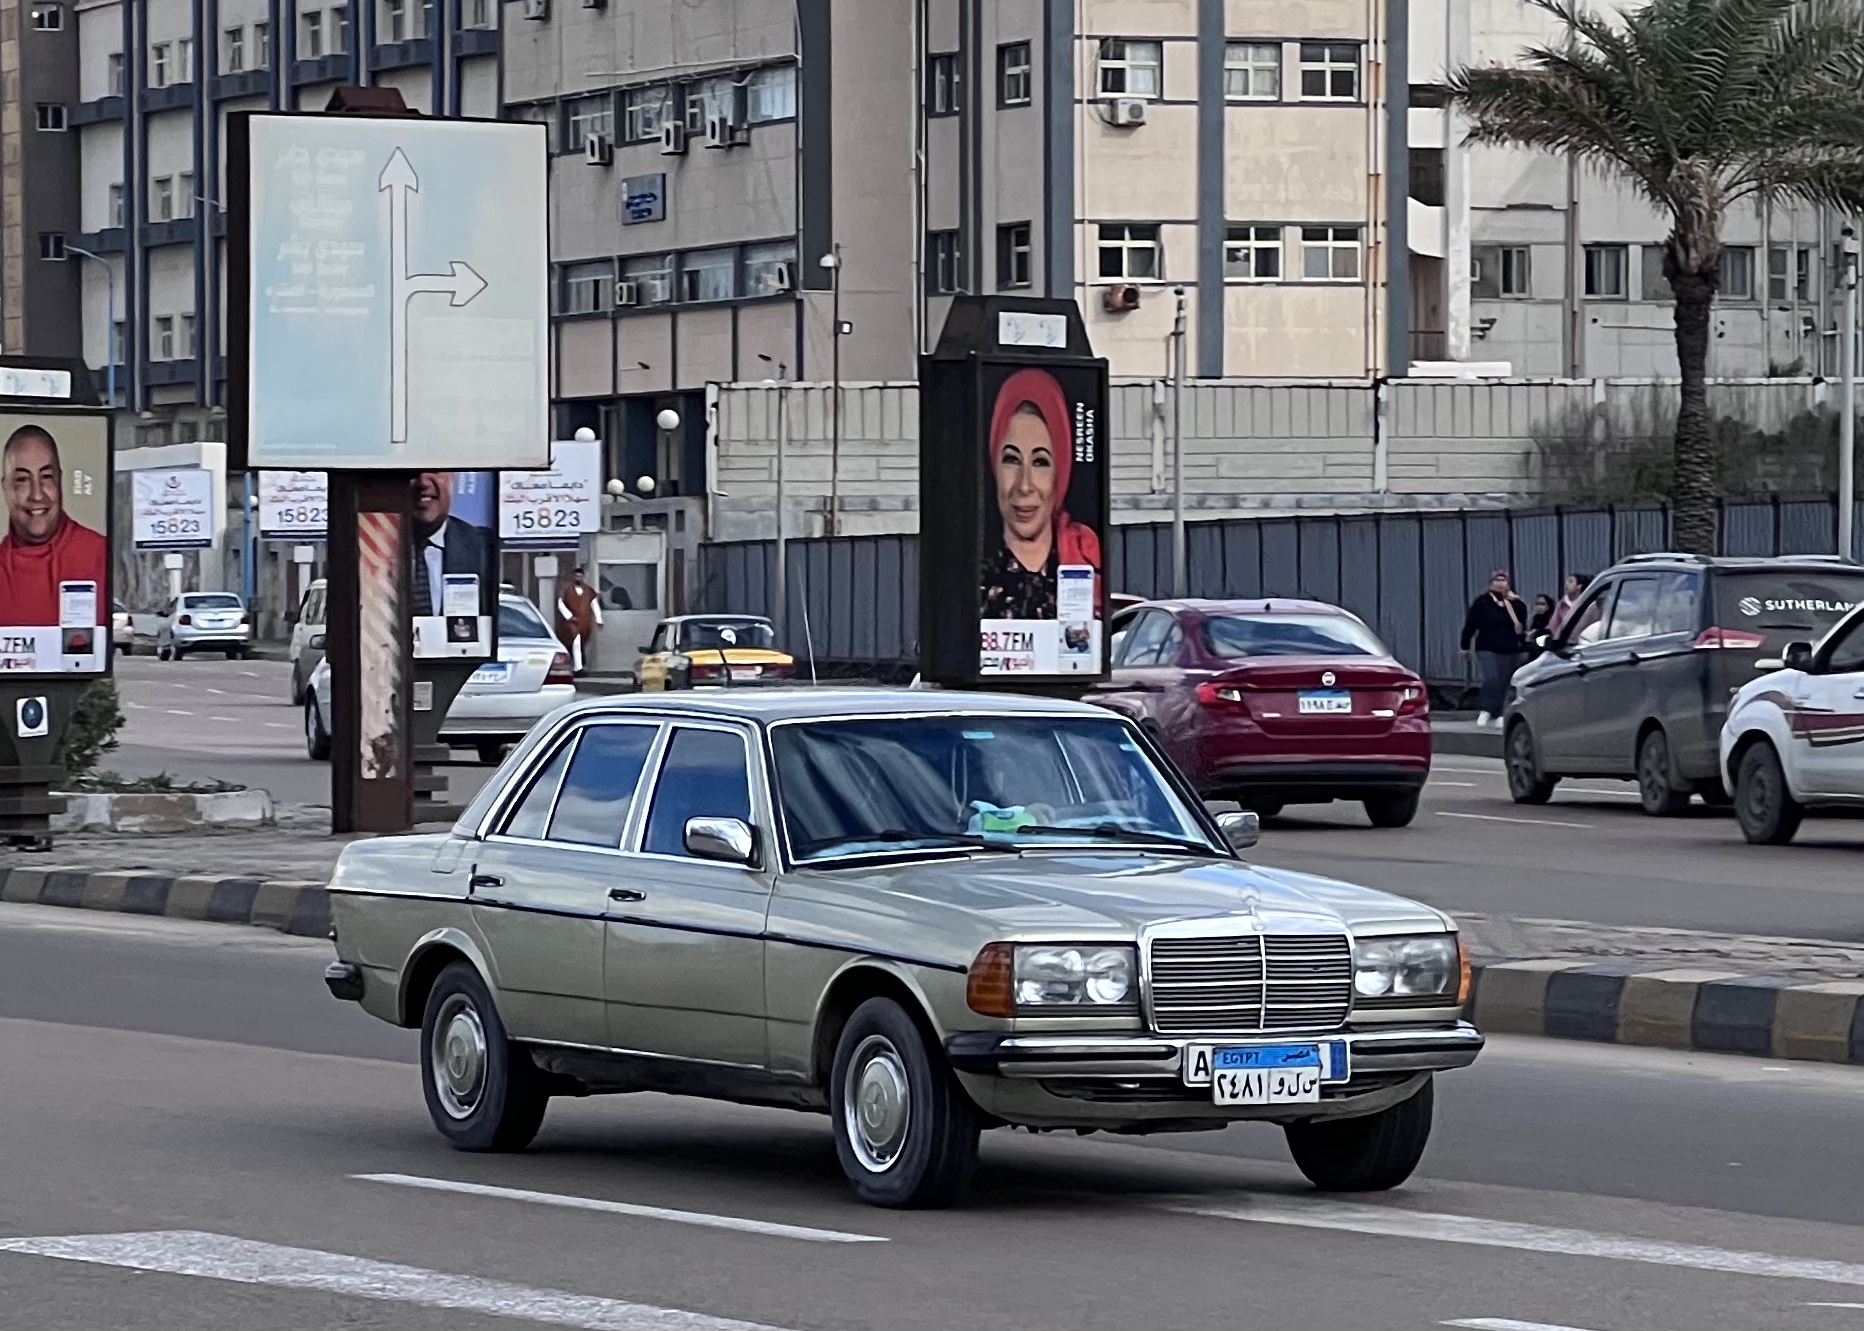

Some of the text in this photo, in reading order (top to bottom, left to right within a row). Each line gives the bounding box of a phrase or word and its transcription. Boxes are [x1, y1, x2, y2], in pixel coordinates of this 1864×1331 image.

[1075, 402, 1085, 462] NESREEN
[1085, 409, 1095, 462] OKASHA
[150, 518, 201, 535] 15823
[513, 507, 581, 529] 15823
[1193, 1051, 1210, 1077] A
[1222, 1051, 1261, 1065] EGYPT
[1281, 1049, 1310, 1063] مصر
[1216, 1073, 1263, 1099] ٢٤٨١
